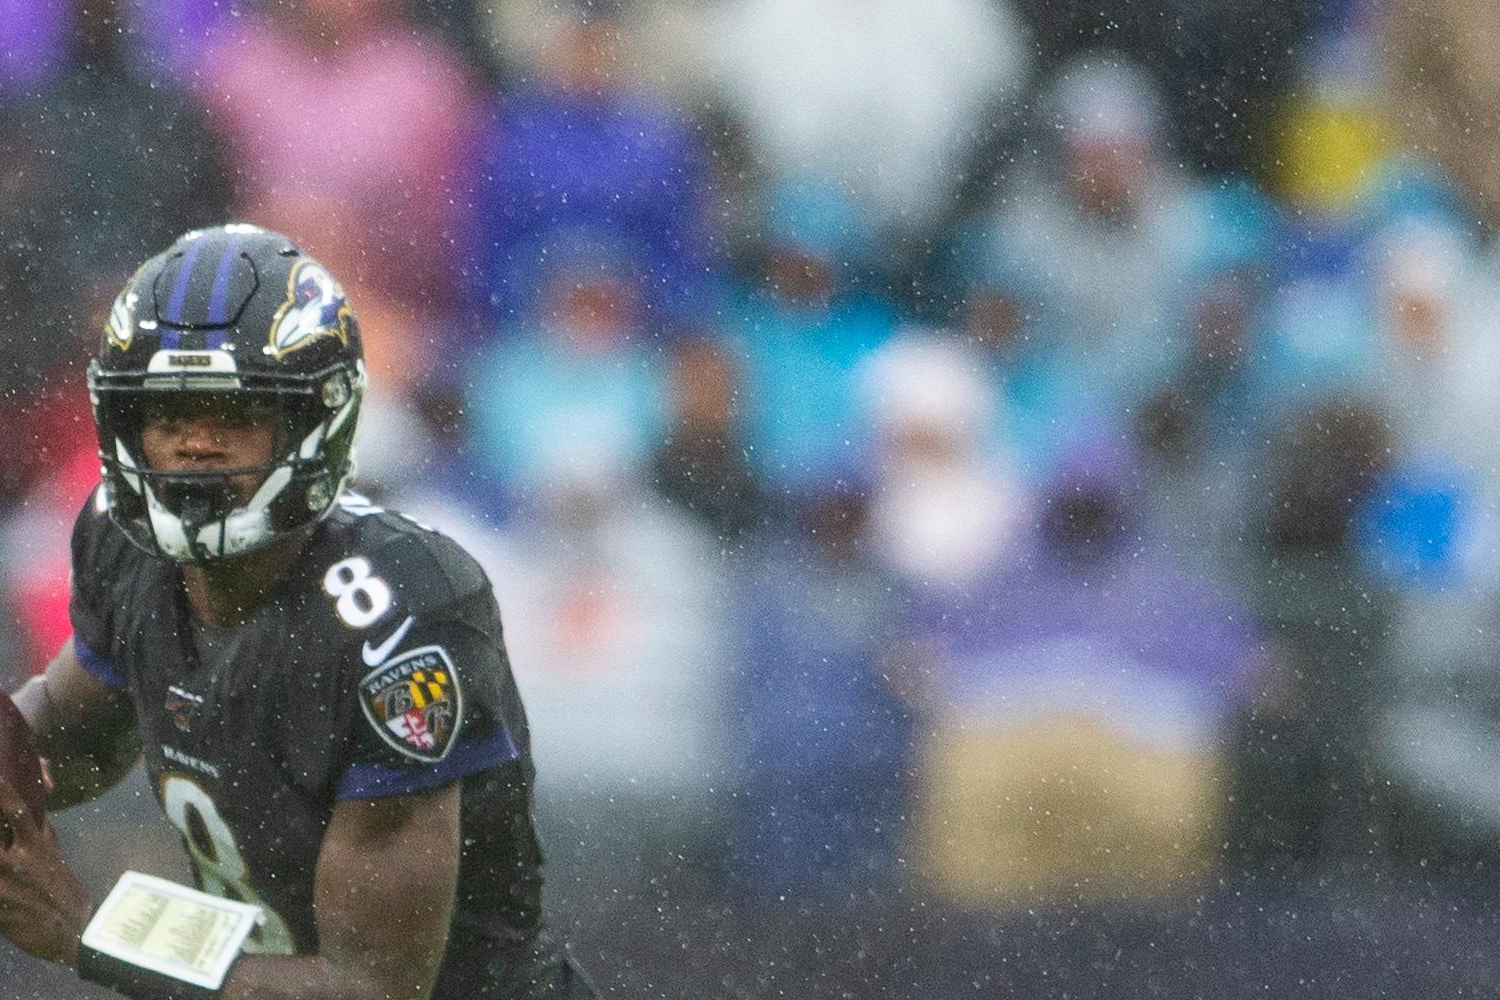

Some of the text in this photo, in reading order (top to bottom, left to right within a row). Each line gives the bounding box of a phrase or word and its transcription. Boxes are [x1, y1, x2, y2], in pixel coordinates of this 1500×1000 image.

[322, 555, 392, 629] 8
[366, 653, 437, 694] RAVENS
[159, 771, 297, 956] 8
